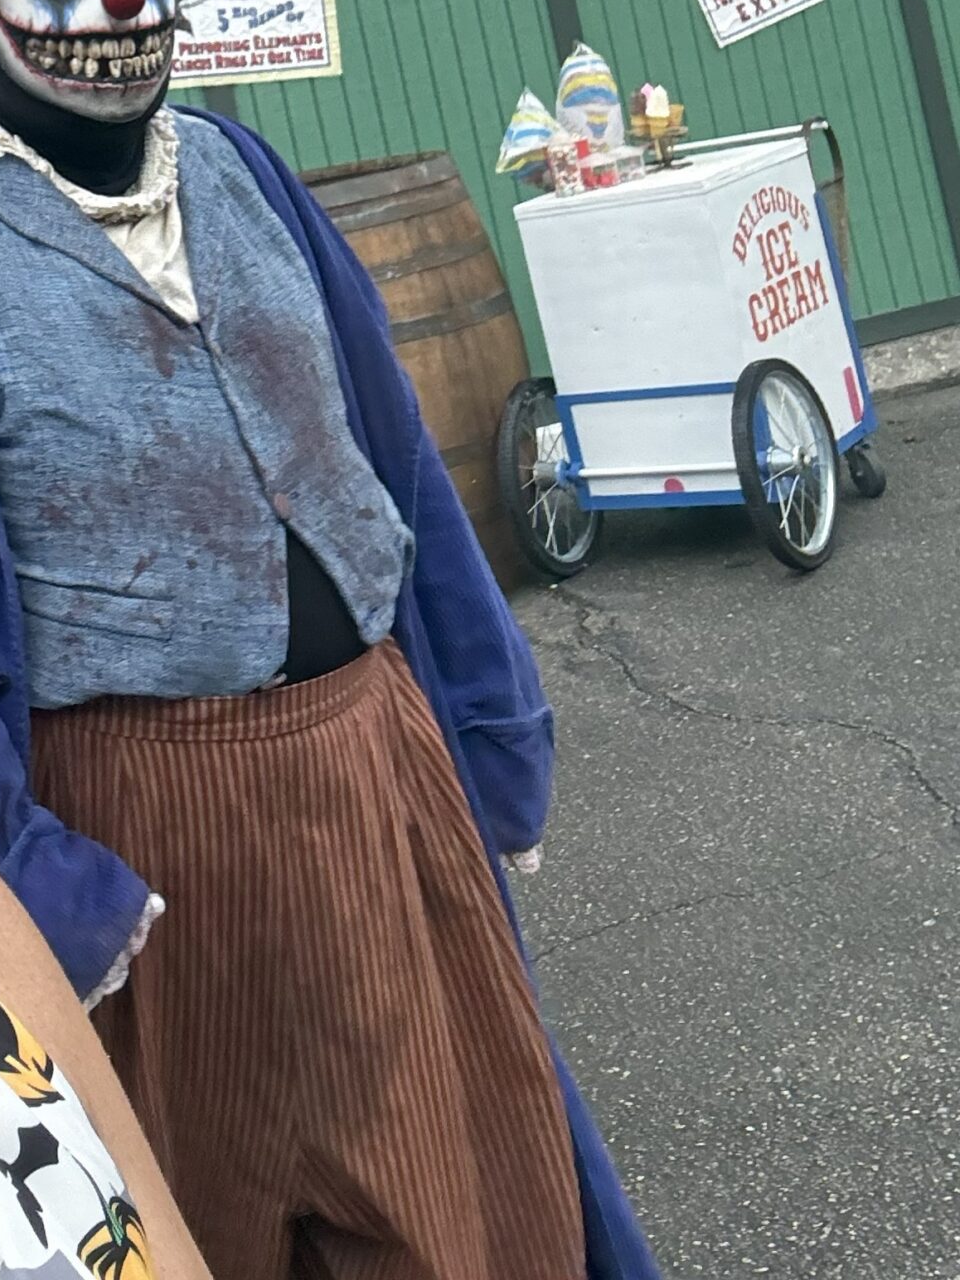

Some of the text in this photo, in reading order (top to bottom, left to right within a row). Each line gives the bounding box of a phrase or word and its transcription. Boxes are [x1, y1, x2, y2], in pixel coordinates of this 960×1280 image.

[217, 9, 229, 33] 5
[732, 186, 810, 266] DELICIOUS
[756, 221, 799, 282] ICE
[748, 259, 829, 342] CREAM
